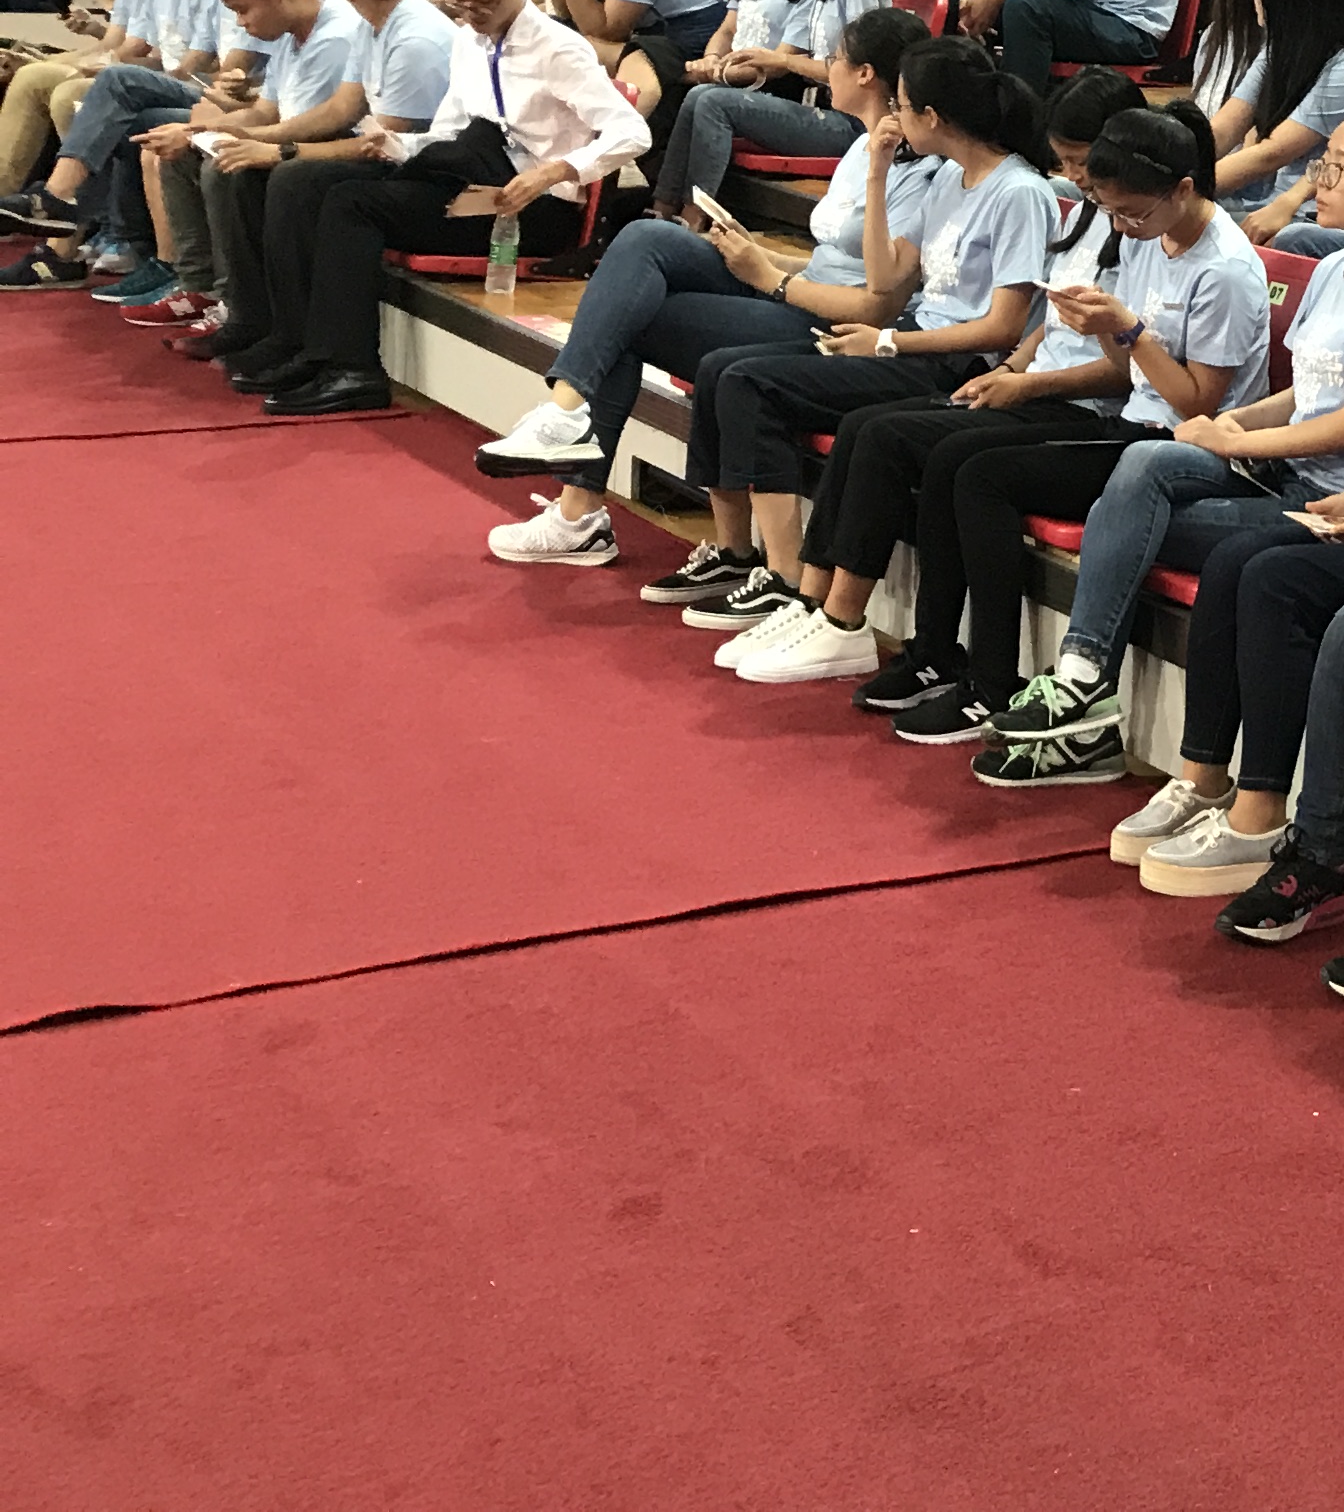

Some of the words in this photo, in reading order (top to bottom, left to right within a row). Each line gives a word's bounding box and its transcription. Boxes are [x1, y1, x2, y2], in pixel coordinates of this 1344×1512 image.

[1269, 285, 1284, 300] 07
[915, 666, 940, 686] N
[961, 701, 990, 722] N
